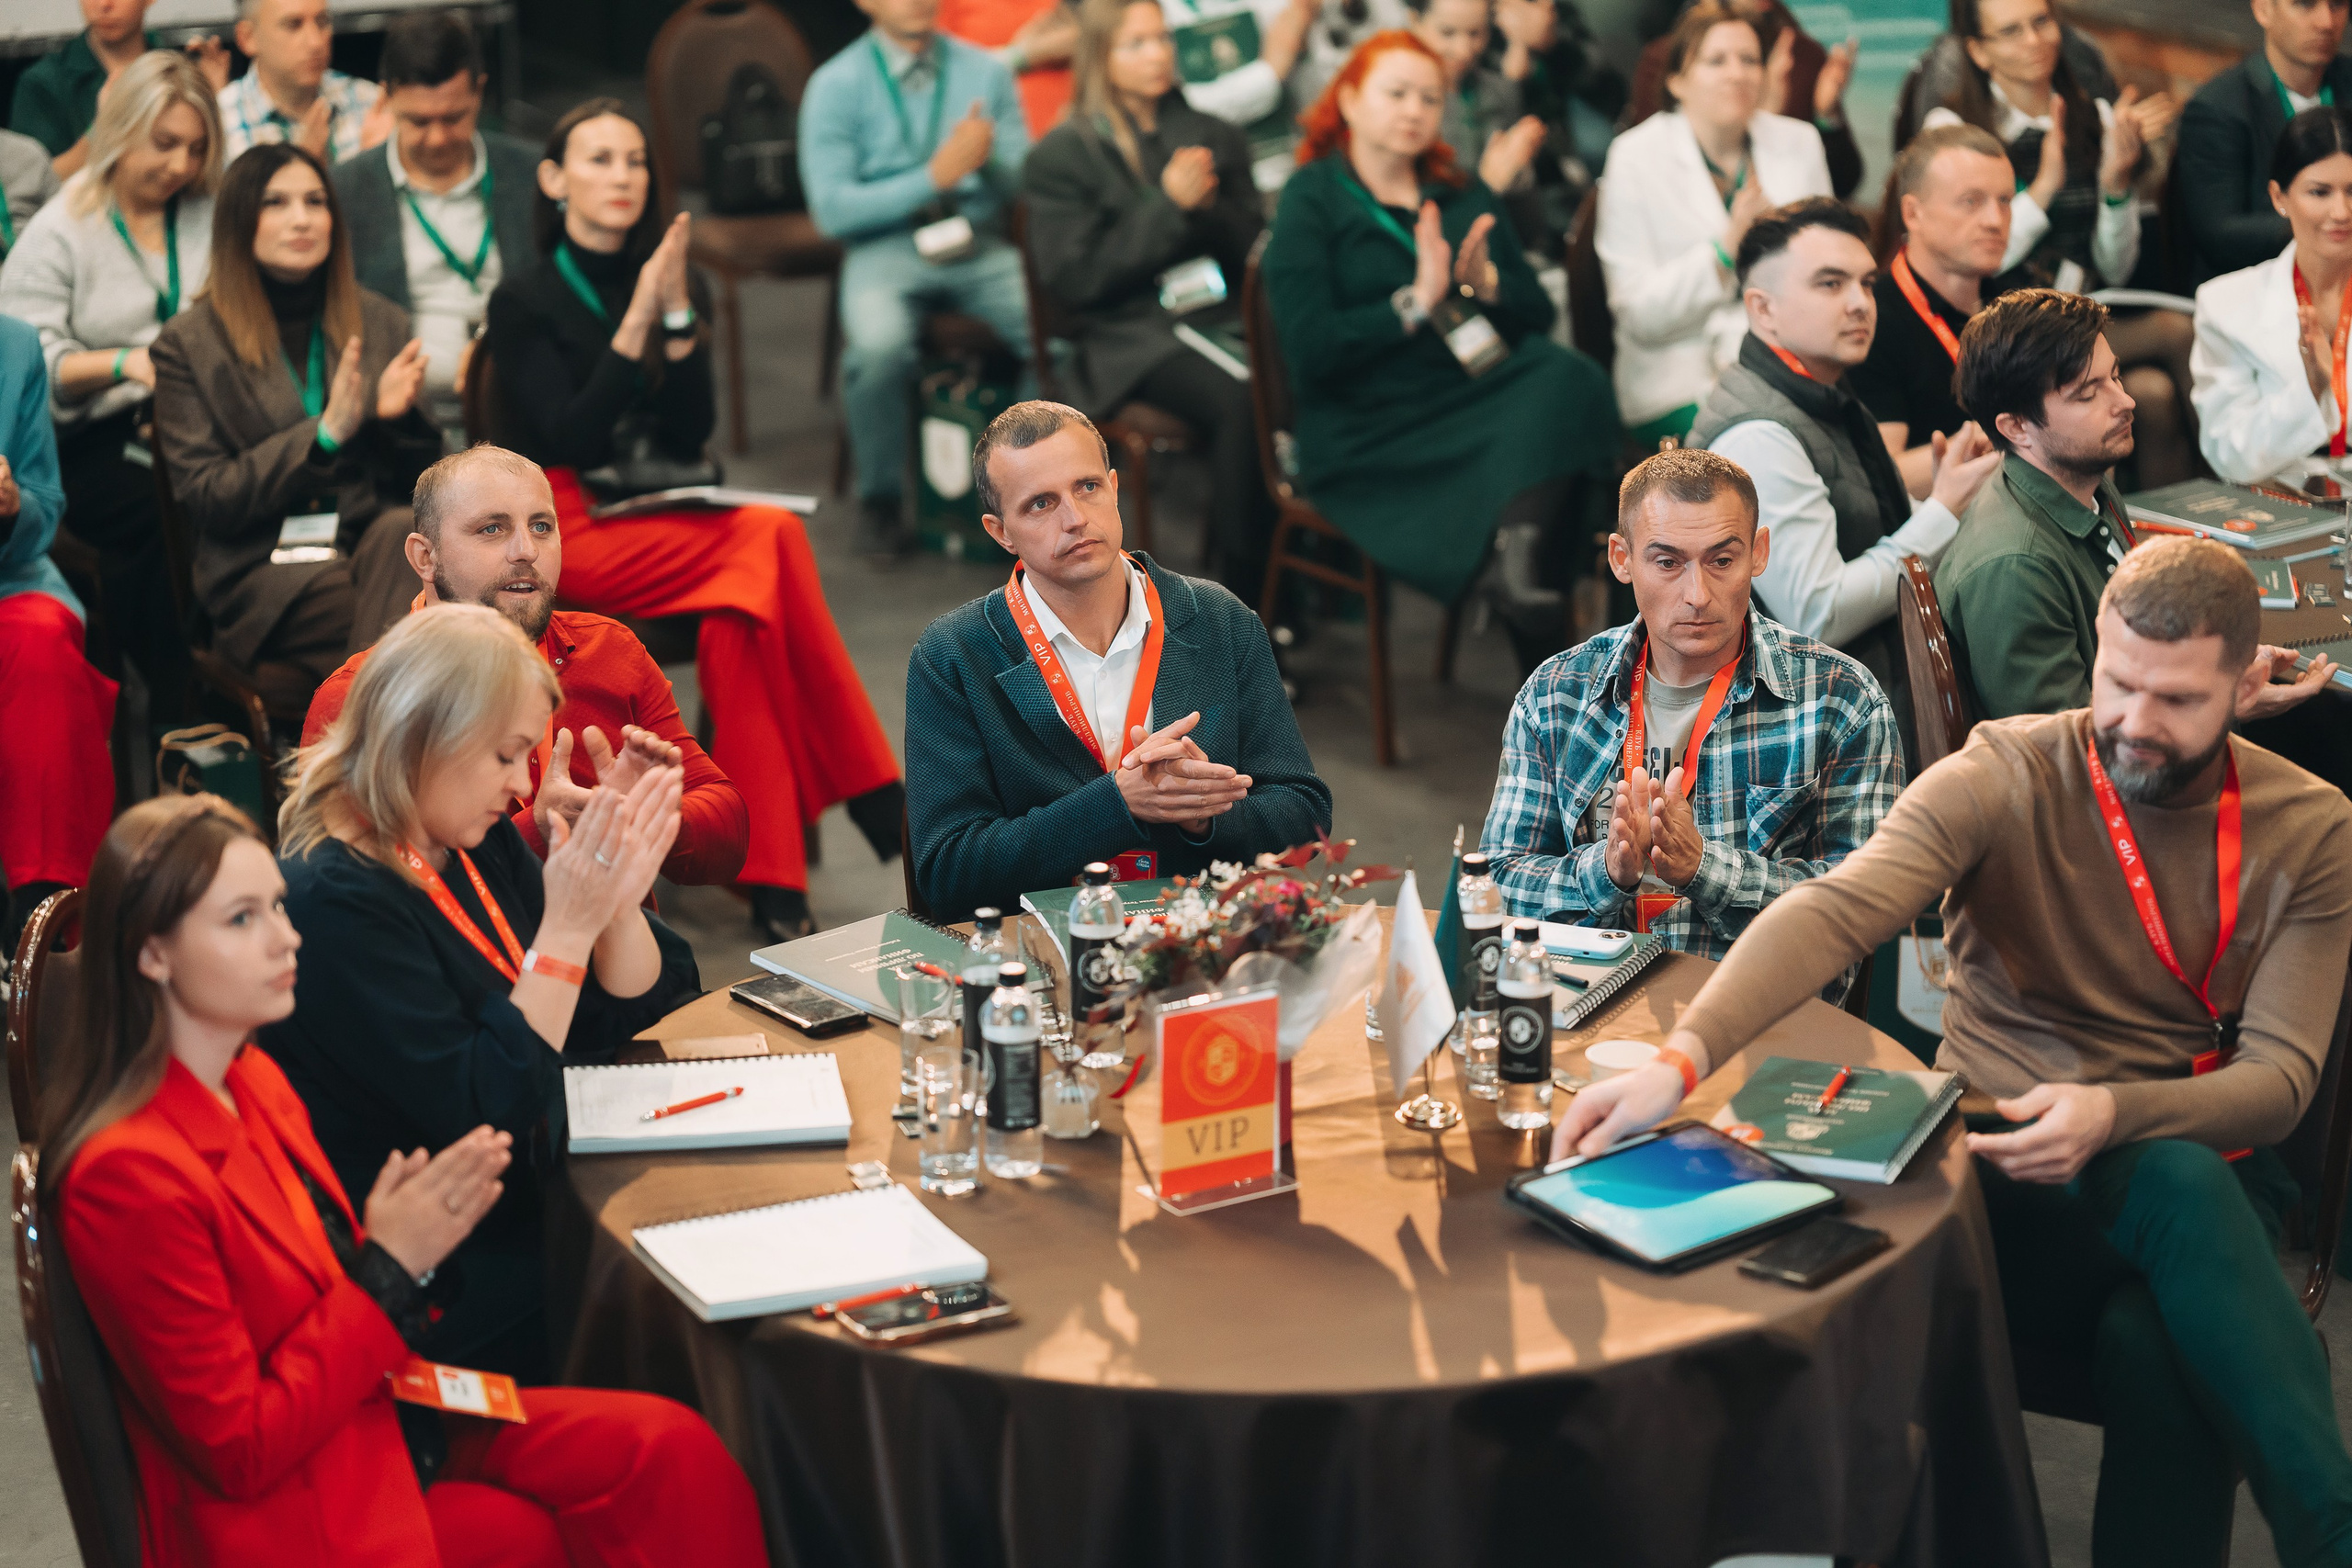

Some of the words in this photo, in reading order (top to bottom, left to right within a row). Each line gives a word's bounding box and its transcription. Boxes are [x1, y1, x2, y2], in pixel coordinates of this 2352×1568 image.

[1034, 642, 1052, 666] VIP
[1634, 660, 1645, 682] VIP
[1064, 691, 1098, 750] МИЛЛИОНЕРОВ
[1067, 714, 1082, 739] КЛУБ
[1634, 729, 1642, 751] КЛУБ
[2118, 838, 2137, 866] VIP
[469, 871, 487, 897] VIP
[1185, 1115, 1250, 1156] VIP
